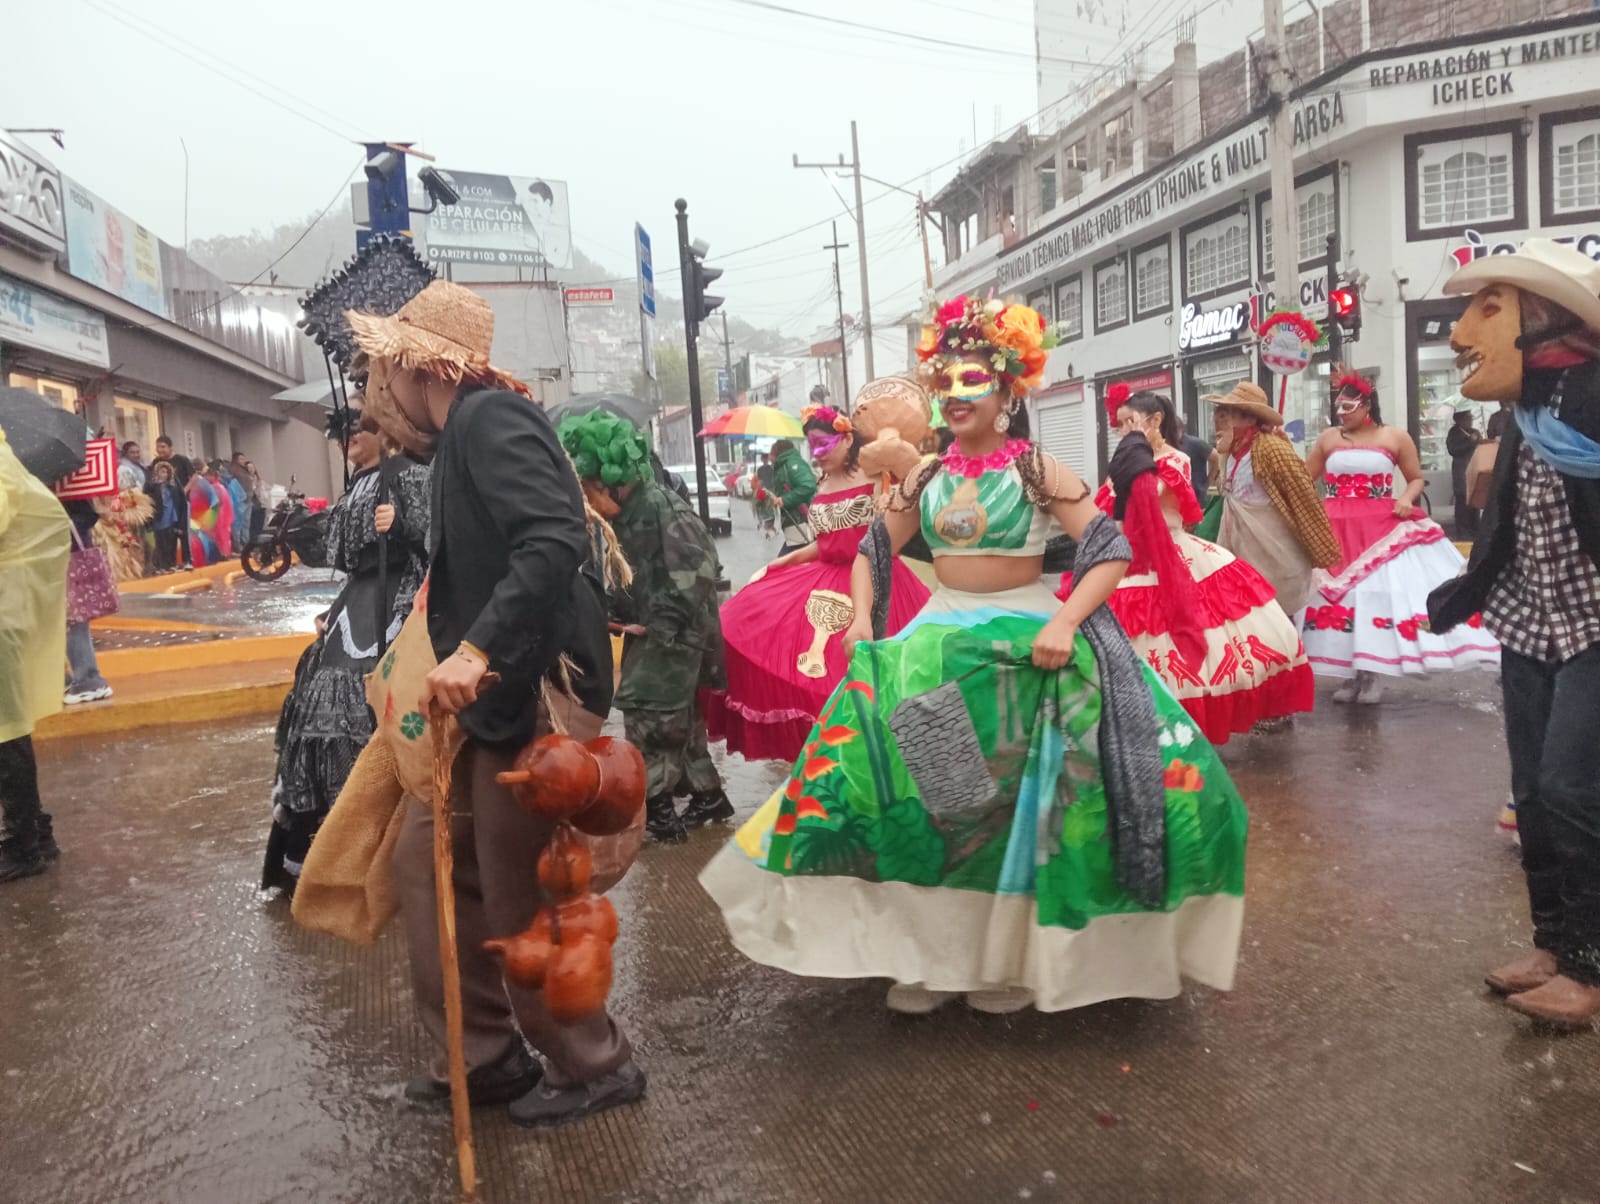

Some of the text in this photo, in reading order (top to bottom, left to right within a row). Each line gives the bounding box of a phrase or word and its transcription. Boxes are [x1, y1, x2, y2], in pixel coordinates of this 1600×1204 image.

[1370, 49, 1491, 87] REPARACIÓN
[1501, 46, 1512, 67] Y
[1432, 71, 1514, 105] ICHECK
[430, 204, 523, 223] REPARACIÓN
[430, 216, 523, 233] DE CELULARES
[997, 252, 1031, 286] SERVICIO
[1032, 231, 1070, 270] TÉCNICO
[1071, 218, 1093, 250] MAC
[1095, 204, 1121, 240] IPOD
[1124, 189, 1151, 225] IPAD
[1155, 159, 1208, 211] IPHONE
[1211, 153, 1222, 184] &
